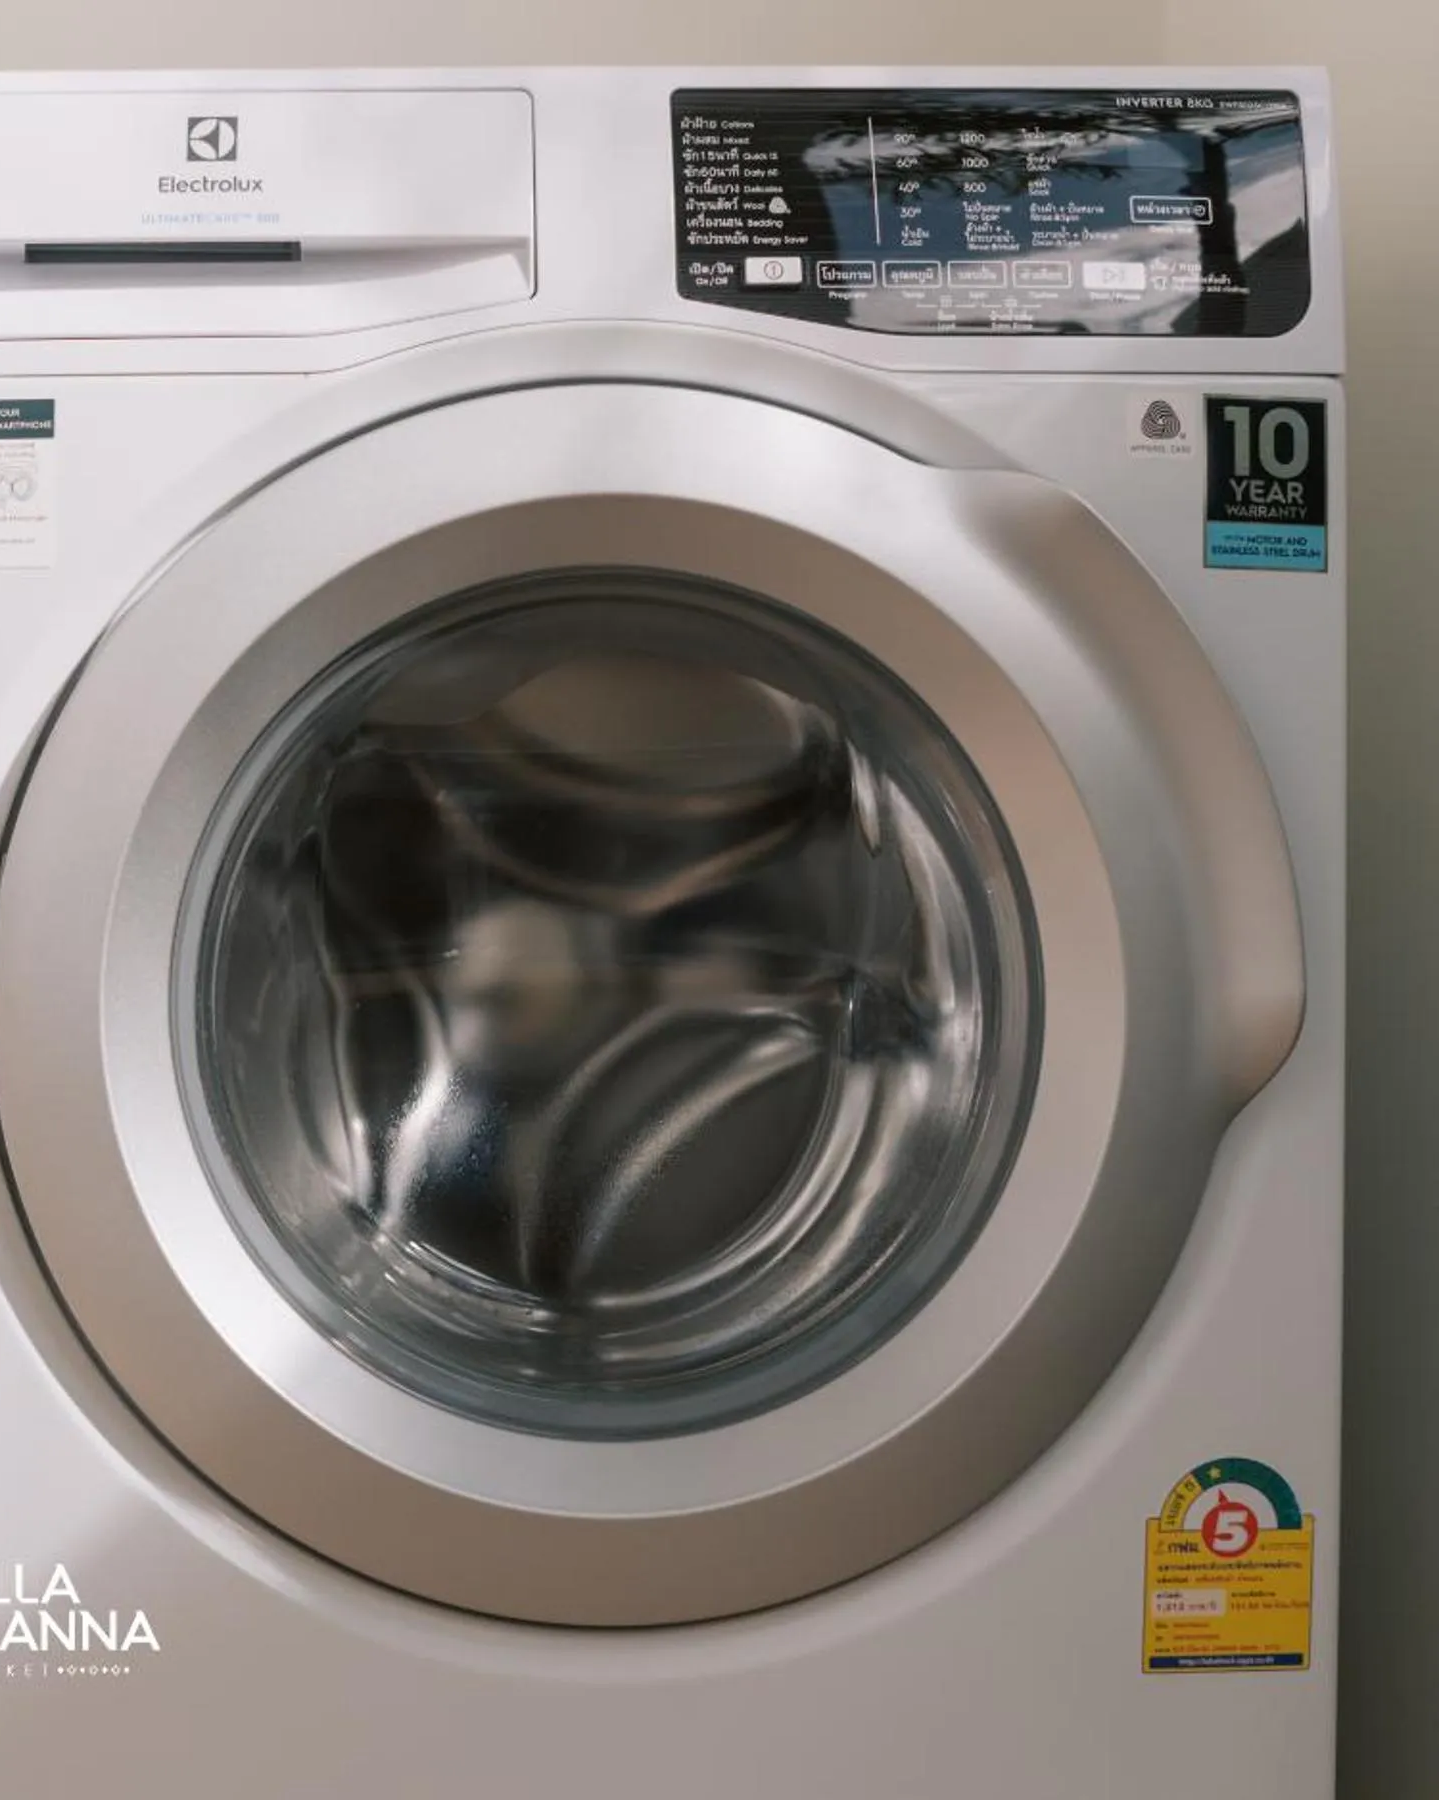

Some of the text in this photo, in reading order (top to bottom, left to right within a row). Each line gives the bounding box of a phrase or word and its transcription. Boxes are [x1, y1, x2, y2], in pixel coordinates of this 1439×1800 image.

[1116, 97, 1183, 109] INVERTER
[1187, 97, 1214, 109] 8KG
[962, 157, 989, 168] 1000
[158, 175, 264, 193] Electrolux
[1223, 405, 1311, 480] 10
[1229, 480, 1305, 504] YEAR
[1225, 504, 1308, 520] WARRANTY
[1246, 535, 1283, 545] MOTOR
[1286, 536, 1308, 546] AND
[1211, 545, 1321, 558] STAINLESS STEEL DRUM
[1211, 1509, 1250, 1555] 5
